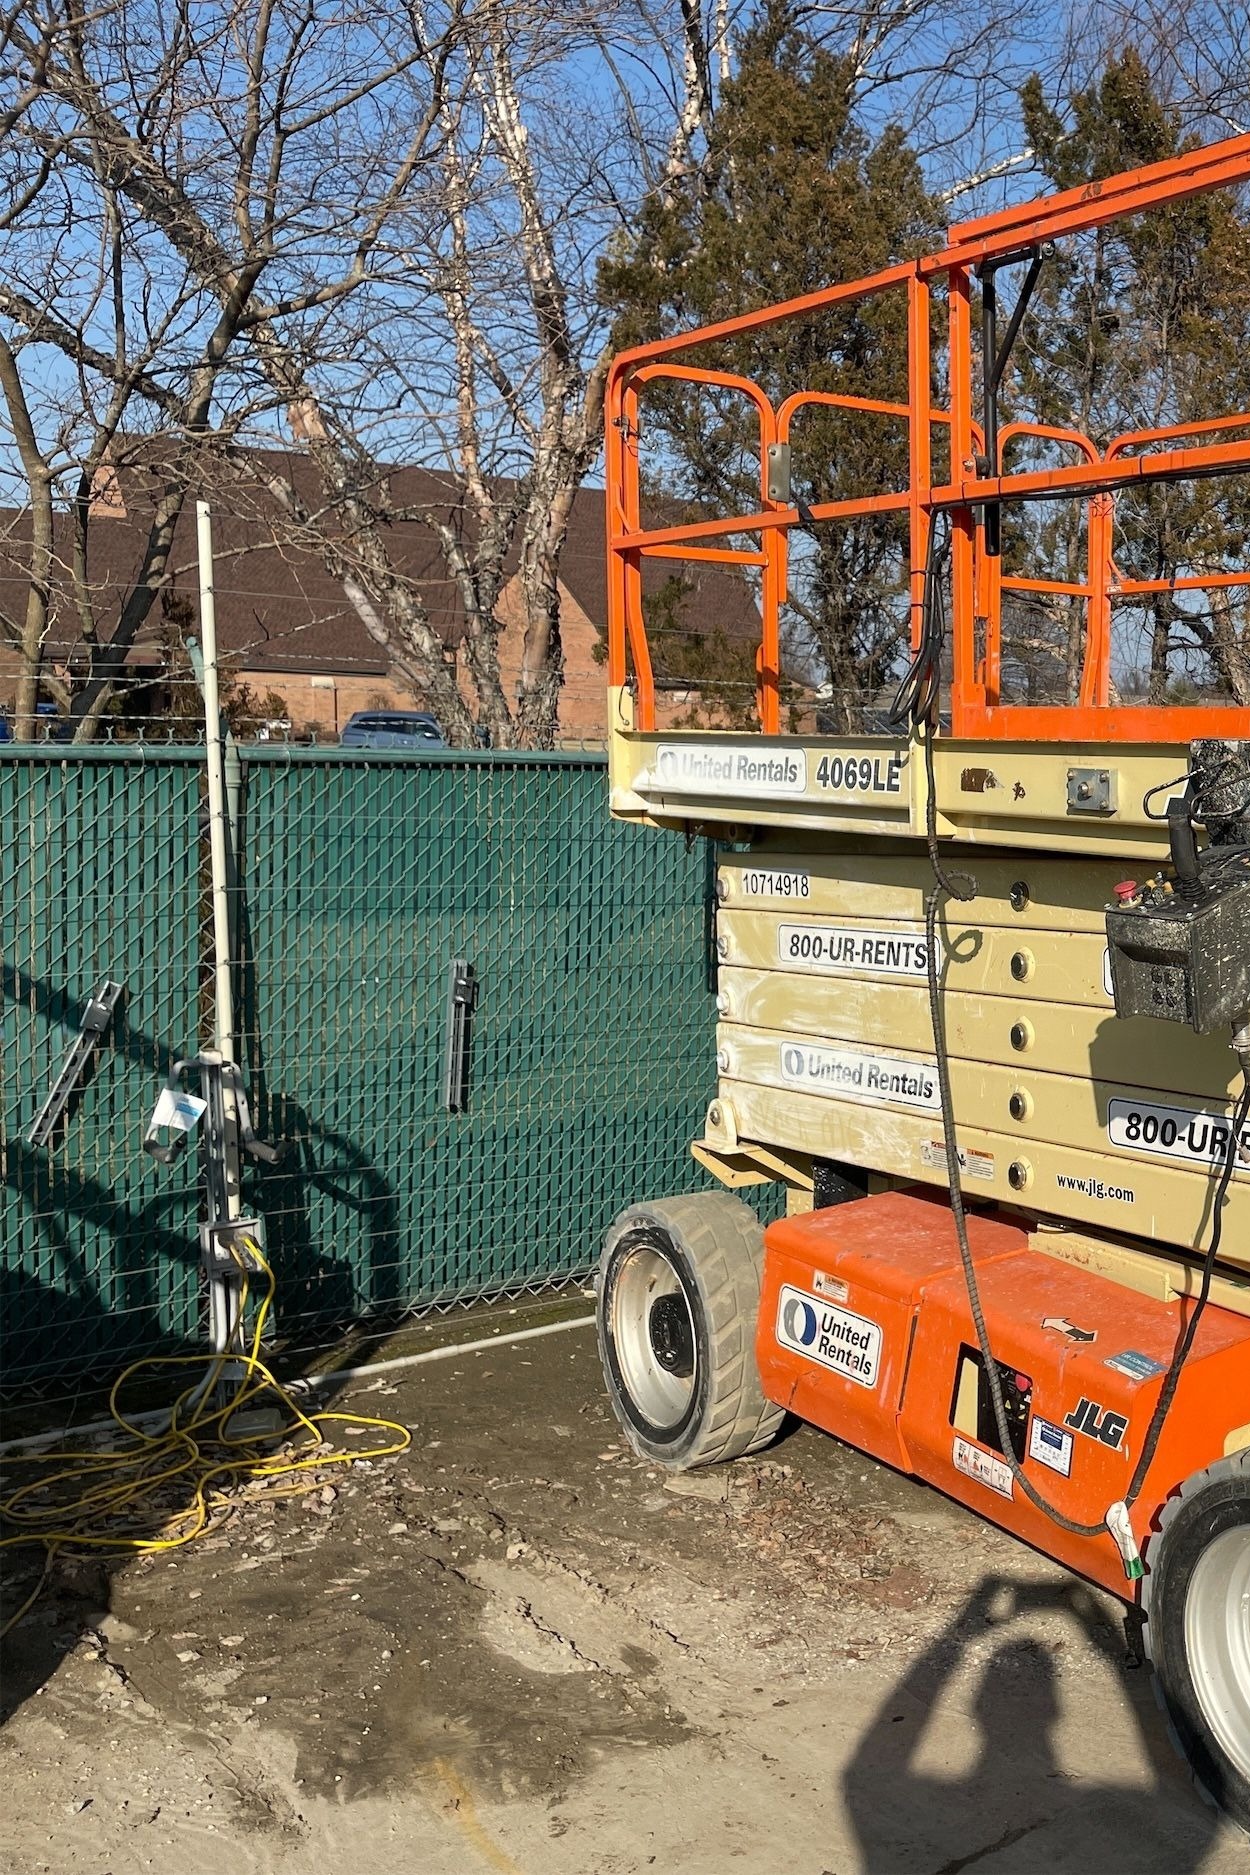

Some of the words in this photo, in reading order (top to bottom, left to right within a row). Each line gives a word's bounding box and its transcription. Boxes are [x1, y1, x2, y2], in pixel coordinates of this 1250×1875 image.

[682, 753, 732, 780] United
[736, 755, 798, 783] Rentals
[816, 756, 902, 793] 4069LE
[743, 873, 809, 897] 10714918
[789, 933, 929, 969] 800-UR-RENTS
[808, 1053, 864, 1086] United
[867, 1063, 934, 1099] Rentals
[1056, 1174, 1135, 1203] www.jlg.com
[821, 1312, 871, 1351] United
[818, 1334, 873, 1376] Rentals
[1064, 1397, 1128, 1449] JLG
